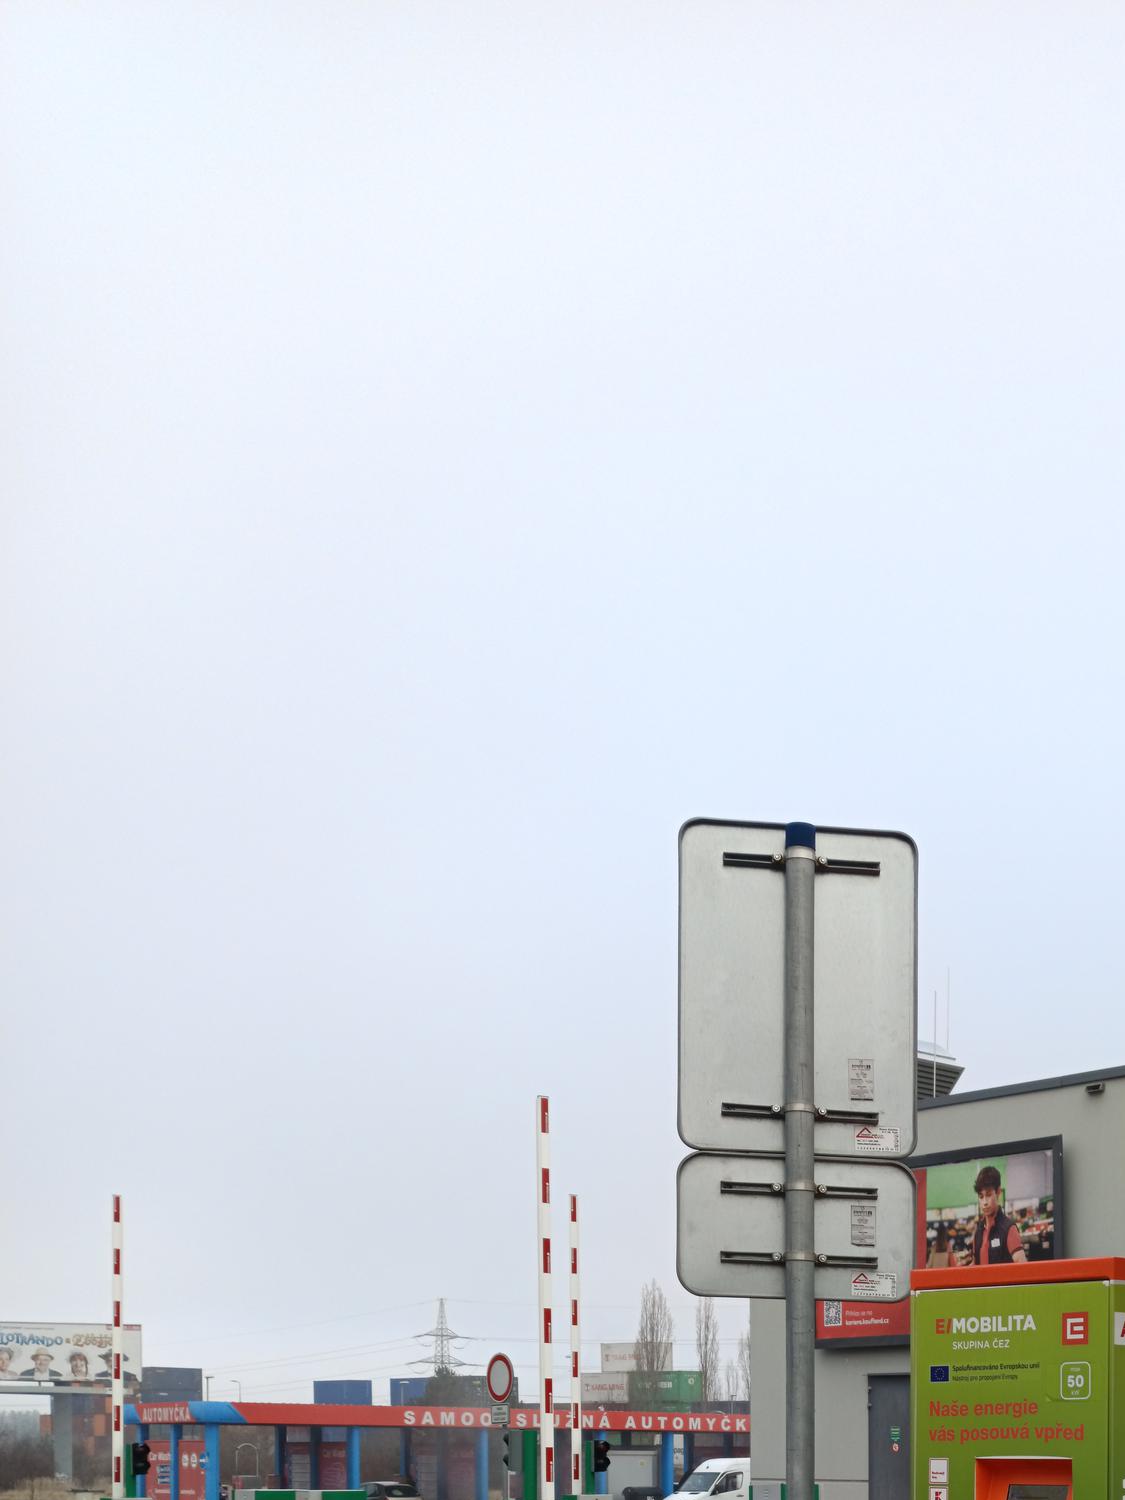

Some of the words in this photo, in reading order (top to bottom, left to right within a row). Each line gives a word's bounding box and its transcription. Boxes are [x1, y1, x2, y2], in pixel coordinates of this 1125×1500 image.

[952, 1339, 990, 1350] SKUPINA
[992, 1338, 1010, 1349] ČEZ
[1067, 1374, 1085, 1388] 50
[143, 1404, 191, 1422] AUTOMYČKA
[929, 1400, 969, 1417] Naše
[974, 1398, 1039, 1419] energie
[403, 1410, 612, 1429] SAMOOSLUŽNÁ
[625, 1414, 747, 1431] AUTOMYČK
[929, 1425, 955, 1442] vás
[960, 1423, 1030, 1445] posouvá
[1035, 1423, 1085, 1444] vpřed
